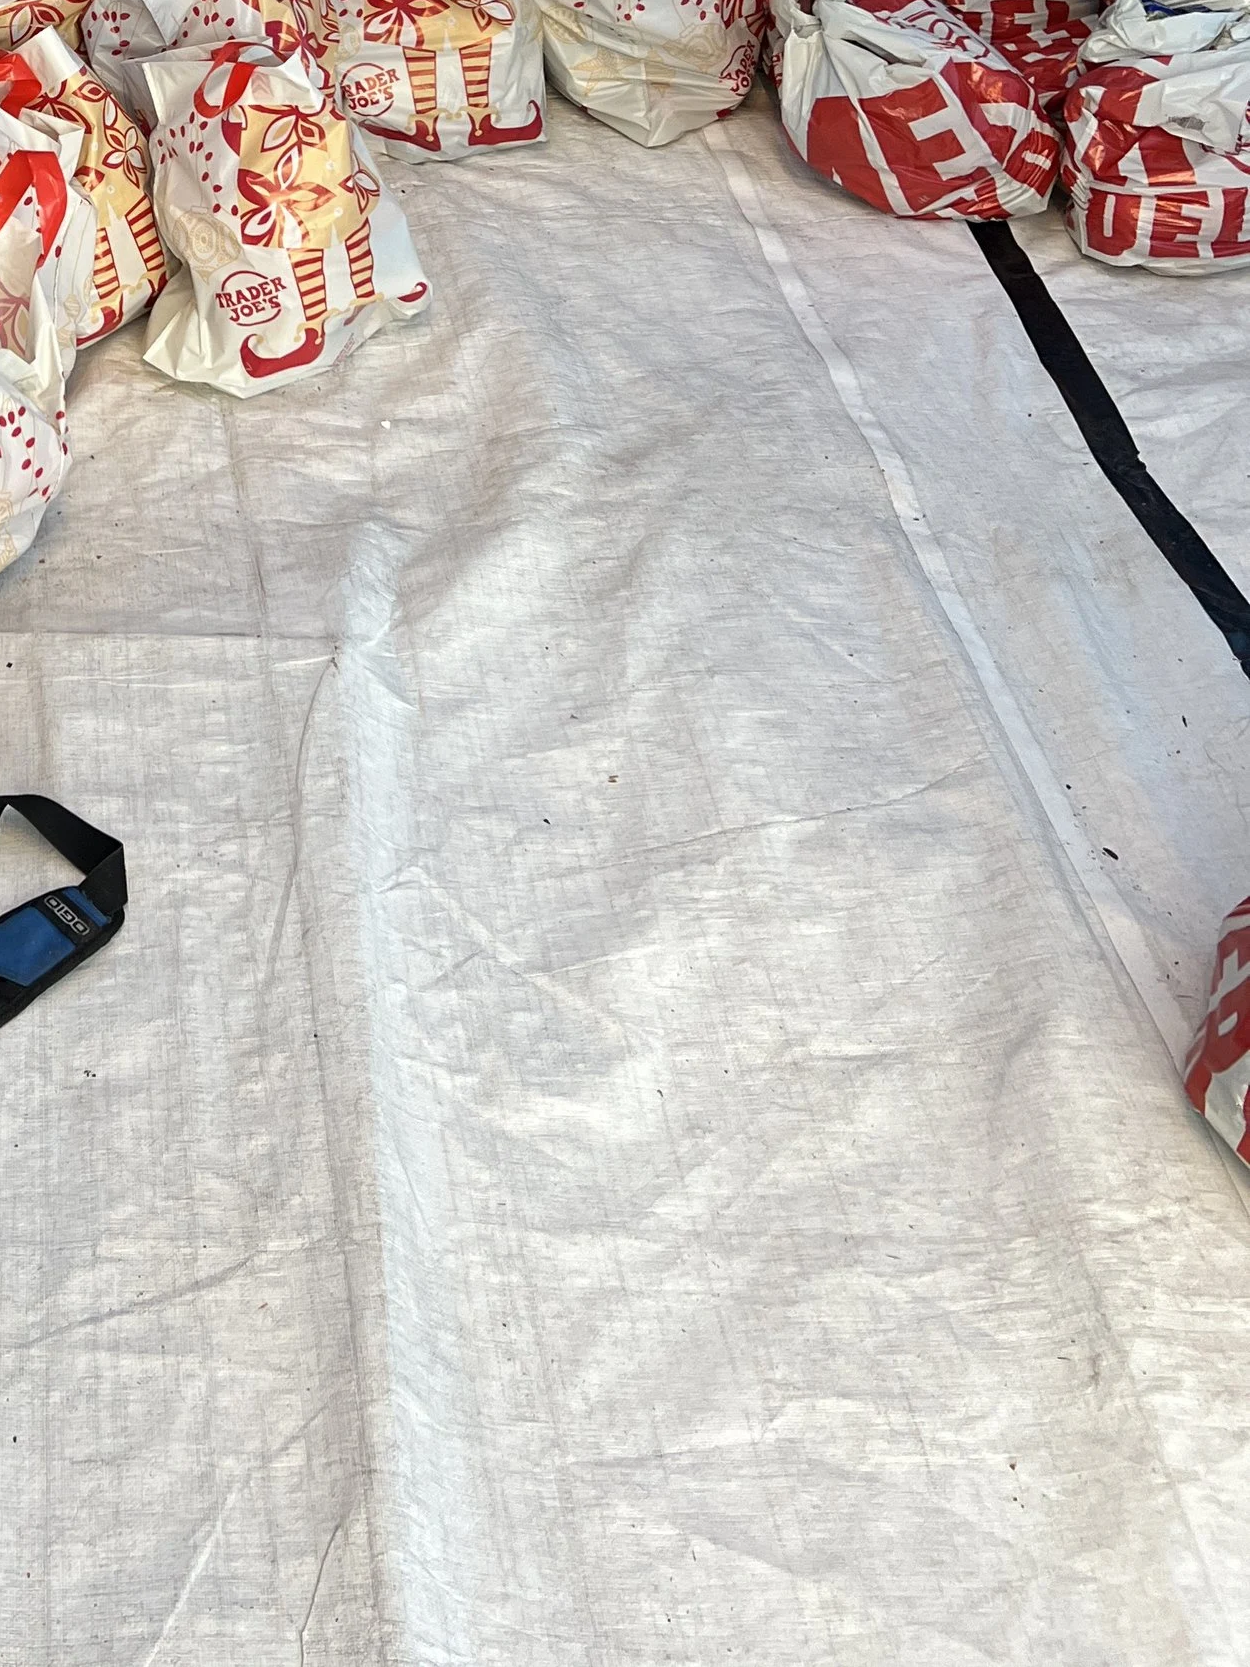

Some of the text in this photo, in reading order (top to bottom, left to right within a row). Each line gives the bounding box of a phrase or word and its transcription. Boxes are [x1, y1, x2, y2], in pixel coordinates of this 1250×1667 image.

[341, 69, 400, 98] RADER
[348, 85, 395, 111] JOE'S
[215, 277, 287, 308] TRADER
[229, 295, 281, 322] JOE'S
[44, 895, 90, 935] OGIO
